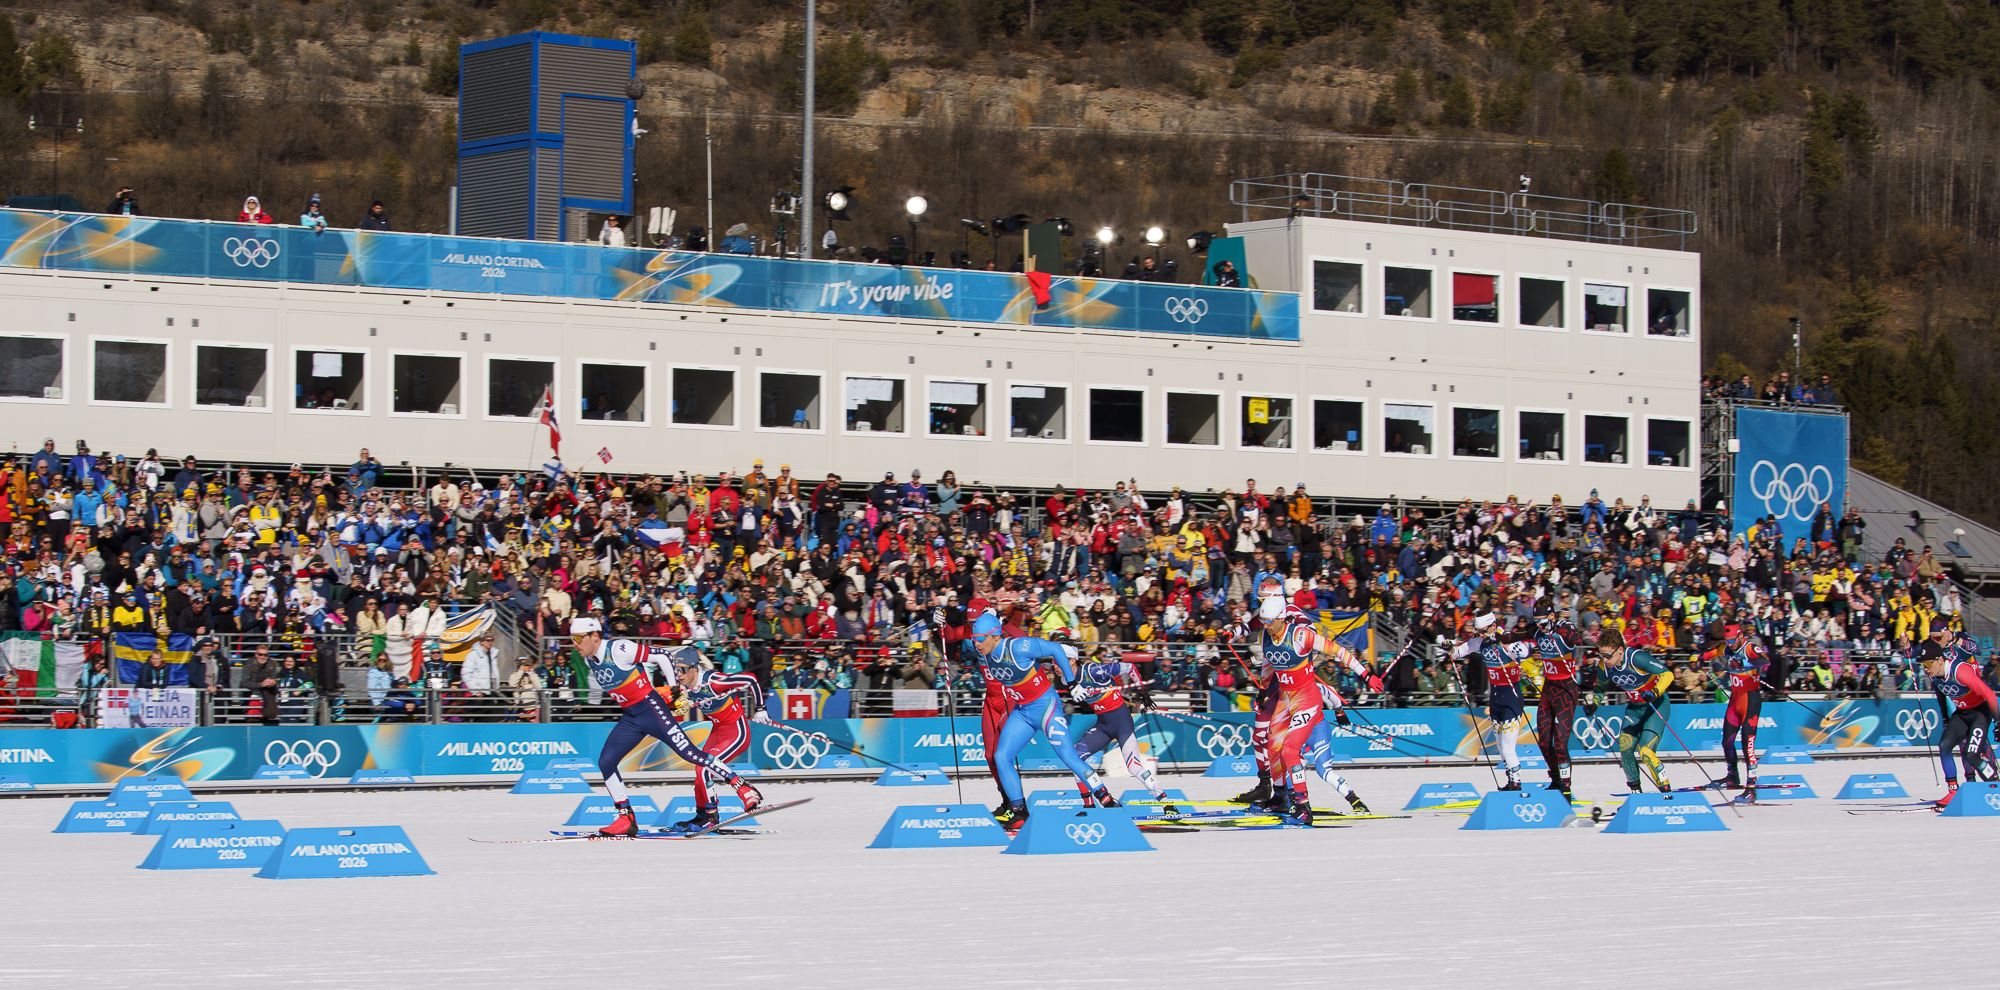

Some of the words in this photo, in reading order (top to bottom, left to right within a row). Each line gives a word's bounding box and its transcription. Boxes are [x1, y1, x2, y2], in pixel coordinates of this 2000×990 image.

[442, 253, 493, 265] MILANO
[494, 256, 545, 269] CORTINA
[481, 267, 506, 278] 2026
[820, 280, 858, 307] IT's
[858, 284, 911, 310] your
[914, 275, 954, 300] vibe
[146, 706, 191, 719] EINAR
[1685, 717, 1724, 730] MILAN
[1048, 715, 1068, 746] ITA
[1332, 724, 1380, 738] MILANO
[1380, 723, 1435, 737] CORTINA
[666, 724, 690, 752] USA
[914, 733, 973, 748] MILANO
[1967, 727, 1984, 753] CZE
[437, 742, 505, 756] MILANO
[507, 741, 578, 755] CORTINA
[0, 748, 55, 763] RTINA
[491, 757, 525, 771] 2026
[74, 811, 114, 820] MILANO
[156, 813, 195, 821] MILANO
[195, 812, 239, 820] CORTINA
[1634, 806, 1671, 816] MILANO
[1671, 805, 1712, 815] CORTINA
[105, 819, 126, 827] 2026
[900, 818, 946, 829] MILANO
[946, 817, 996, 828] CORTINA
[937, 829, 963, 839] 2026
[171, 837, 228, 849] MILANO
[290, 845, 349, 857] MILANO
[350, 842, 412, 855] CORTINA
[217, 849, 247, 860] 2026
[337, 857, 368, 869] 2026
